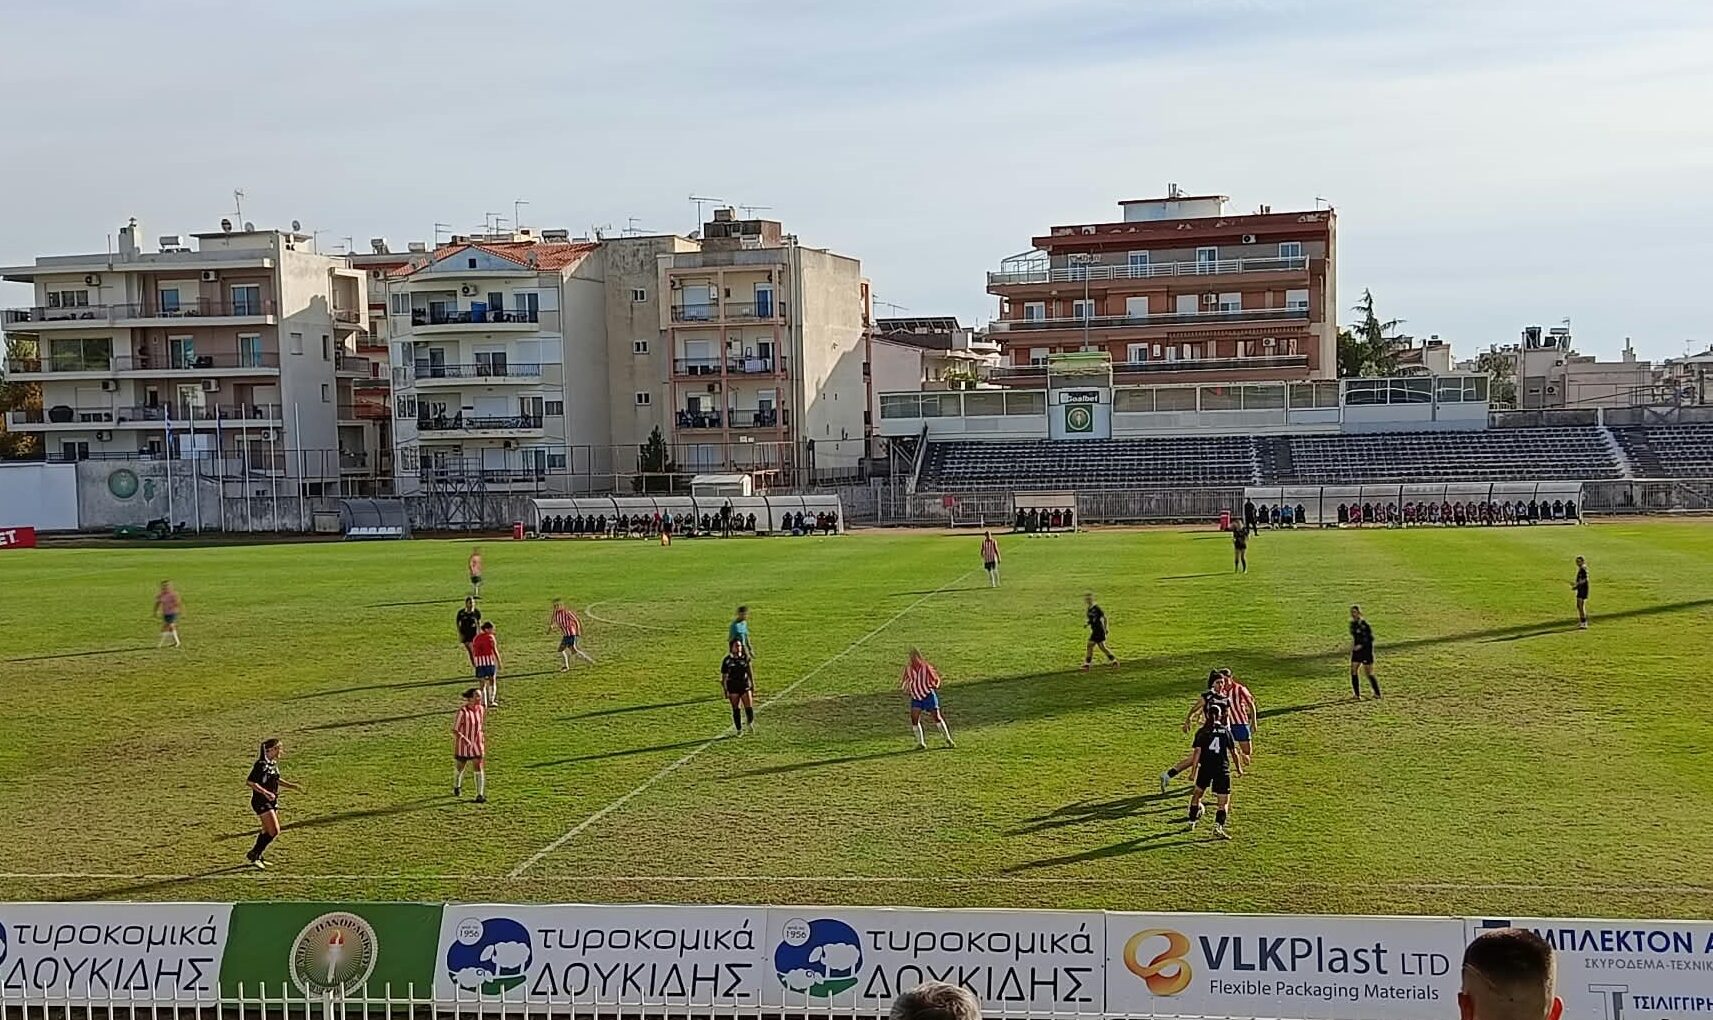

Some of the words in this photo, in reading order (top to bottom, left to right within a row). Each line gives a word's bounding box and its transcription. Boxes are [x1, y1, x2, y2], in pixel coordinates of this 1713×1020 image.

[1208, 737, 1221, 753] 4
[13, 915, 218, 953] τυροκομικά
[537, 919, 756, 958] τυροκομικά
[866, 922, 1094, 962] τυροκομικά
[3, 957, 214, 991] ΔΟΥΚΙΔΗΣ
[1198, 935, 1389, 975] VLKPlast
[1401, 952, 1450, 976] LTD
[530, 962, 753, 998] ΔΟΥΚΙΔΗΣ
[1209, 979, 1272, 996] Flexible
[1276, 981, 1359, 1001] Packaging
[1363, 982, 1439, 1000] Materials
